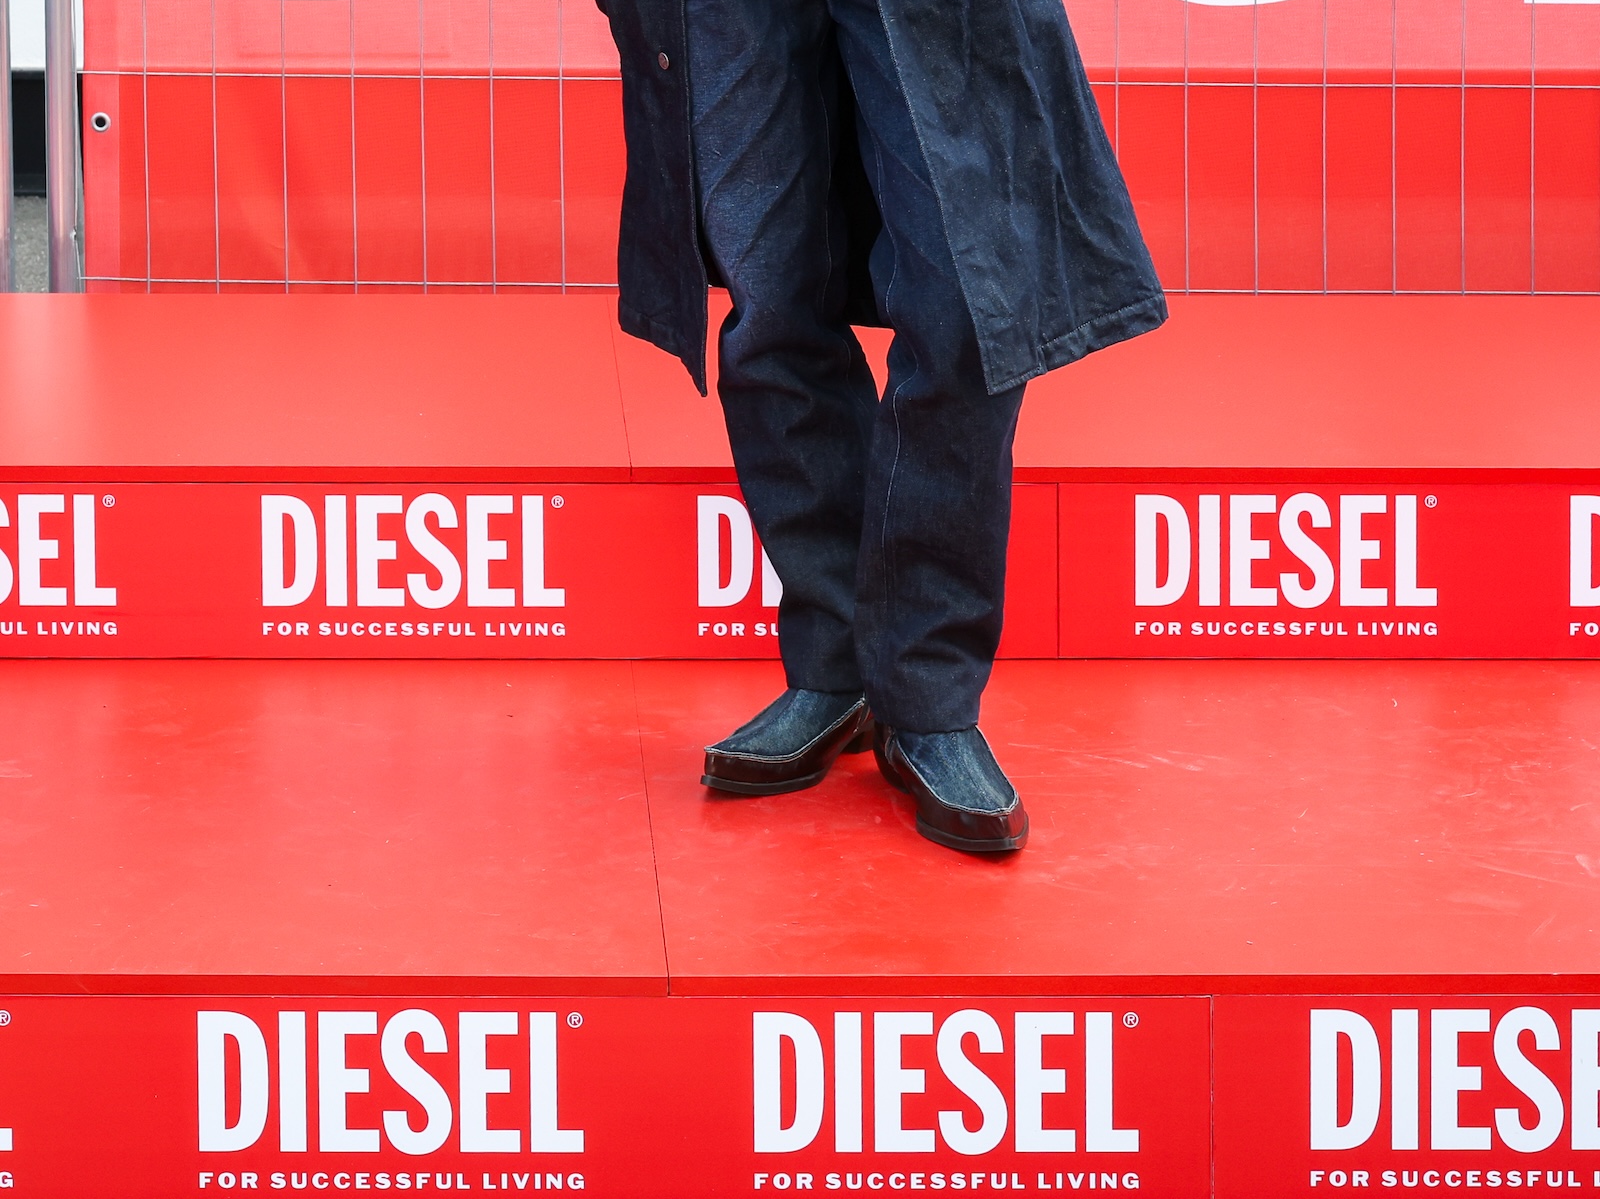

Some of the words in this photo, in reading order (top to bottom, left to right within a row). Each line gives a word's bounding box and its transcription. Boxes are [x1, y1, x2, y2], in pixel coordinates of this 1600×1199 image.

[261, 492, 566, 609] DIESEL
[1134, 492, 1438, 609] DIESEL
[37, 621, 118, 635] LIVING
[262, 622, 310, 636] FOR
[318, 622, 476, 636] SUCCESSFUL
[485, 622, 566, 636] LIVING
[698, 622, 745, 636] FOR
[1135, 622, 1182, 636] FOR
[1191, 622, 1348, 636] SUCCESSFUL
[1357, 622, 1438, 636] LIVING
[197, 1008, 585, 1156] DIESEL
[752, 1009, 1140, 1156] DIESEL
[199, 1172, 258, 1189] FOR
[270, 1172, 471, 1190] SUCCESSFUL
[482, 1173, 585, 1190] LIVING
[754, 1173, 813, 1190] FOR
[825, 1172, 1025, 1190] SUCCESSFUL
[1037, 1172, 1140, 1189] LIVING
[1310, 1170, 1369, 1187] FOR
[1381, 1170, 1581, 1187] SUCCESSFUL
